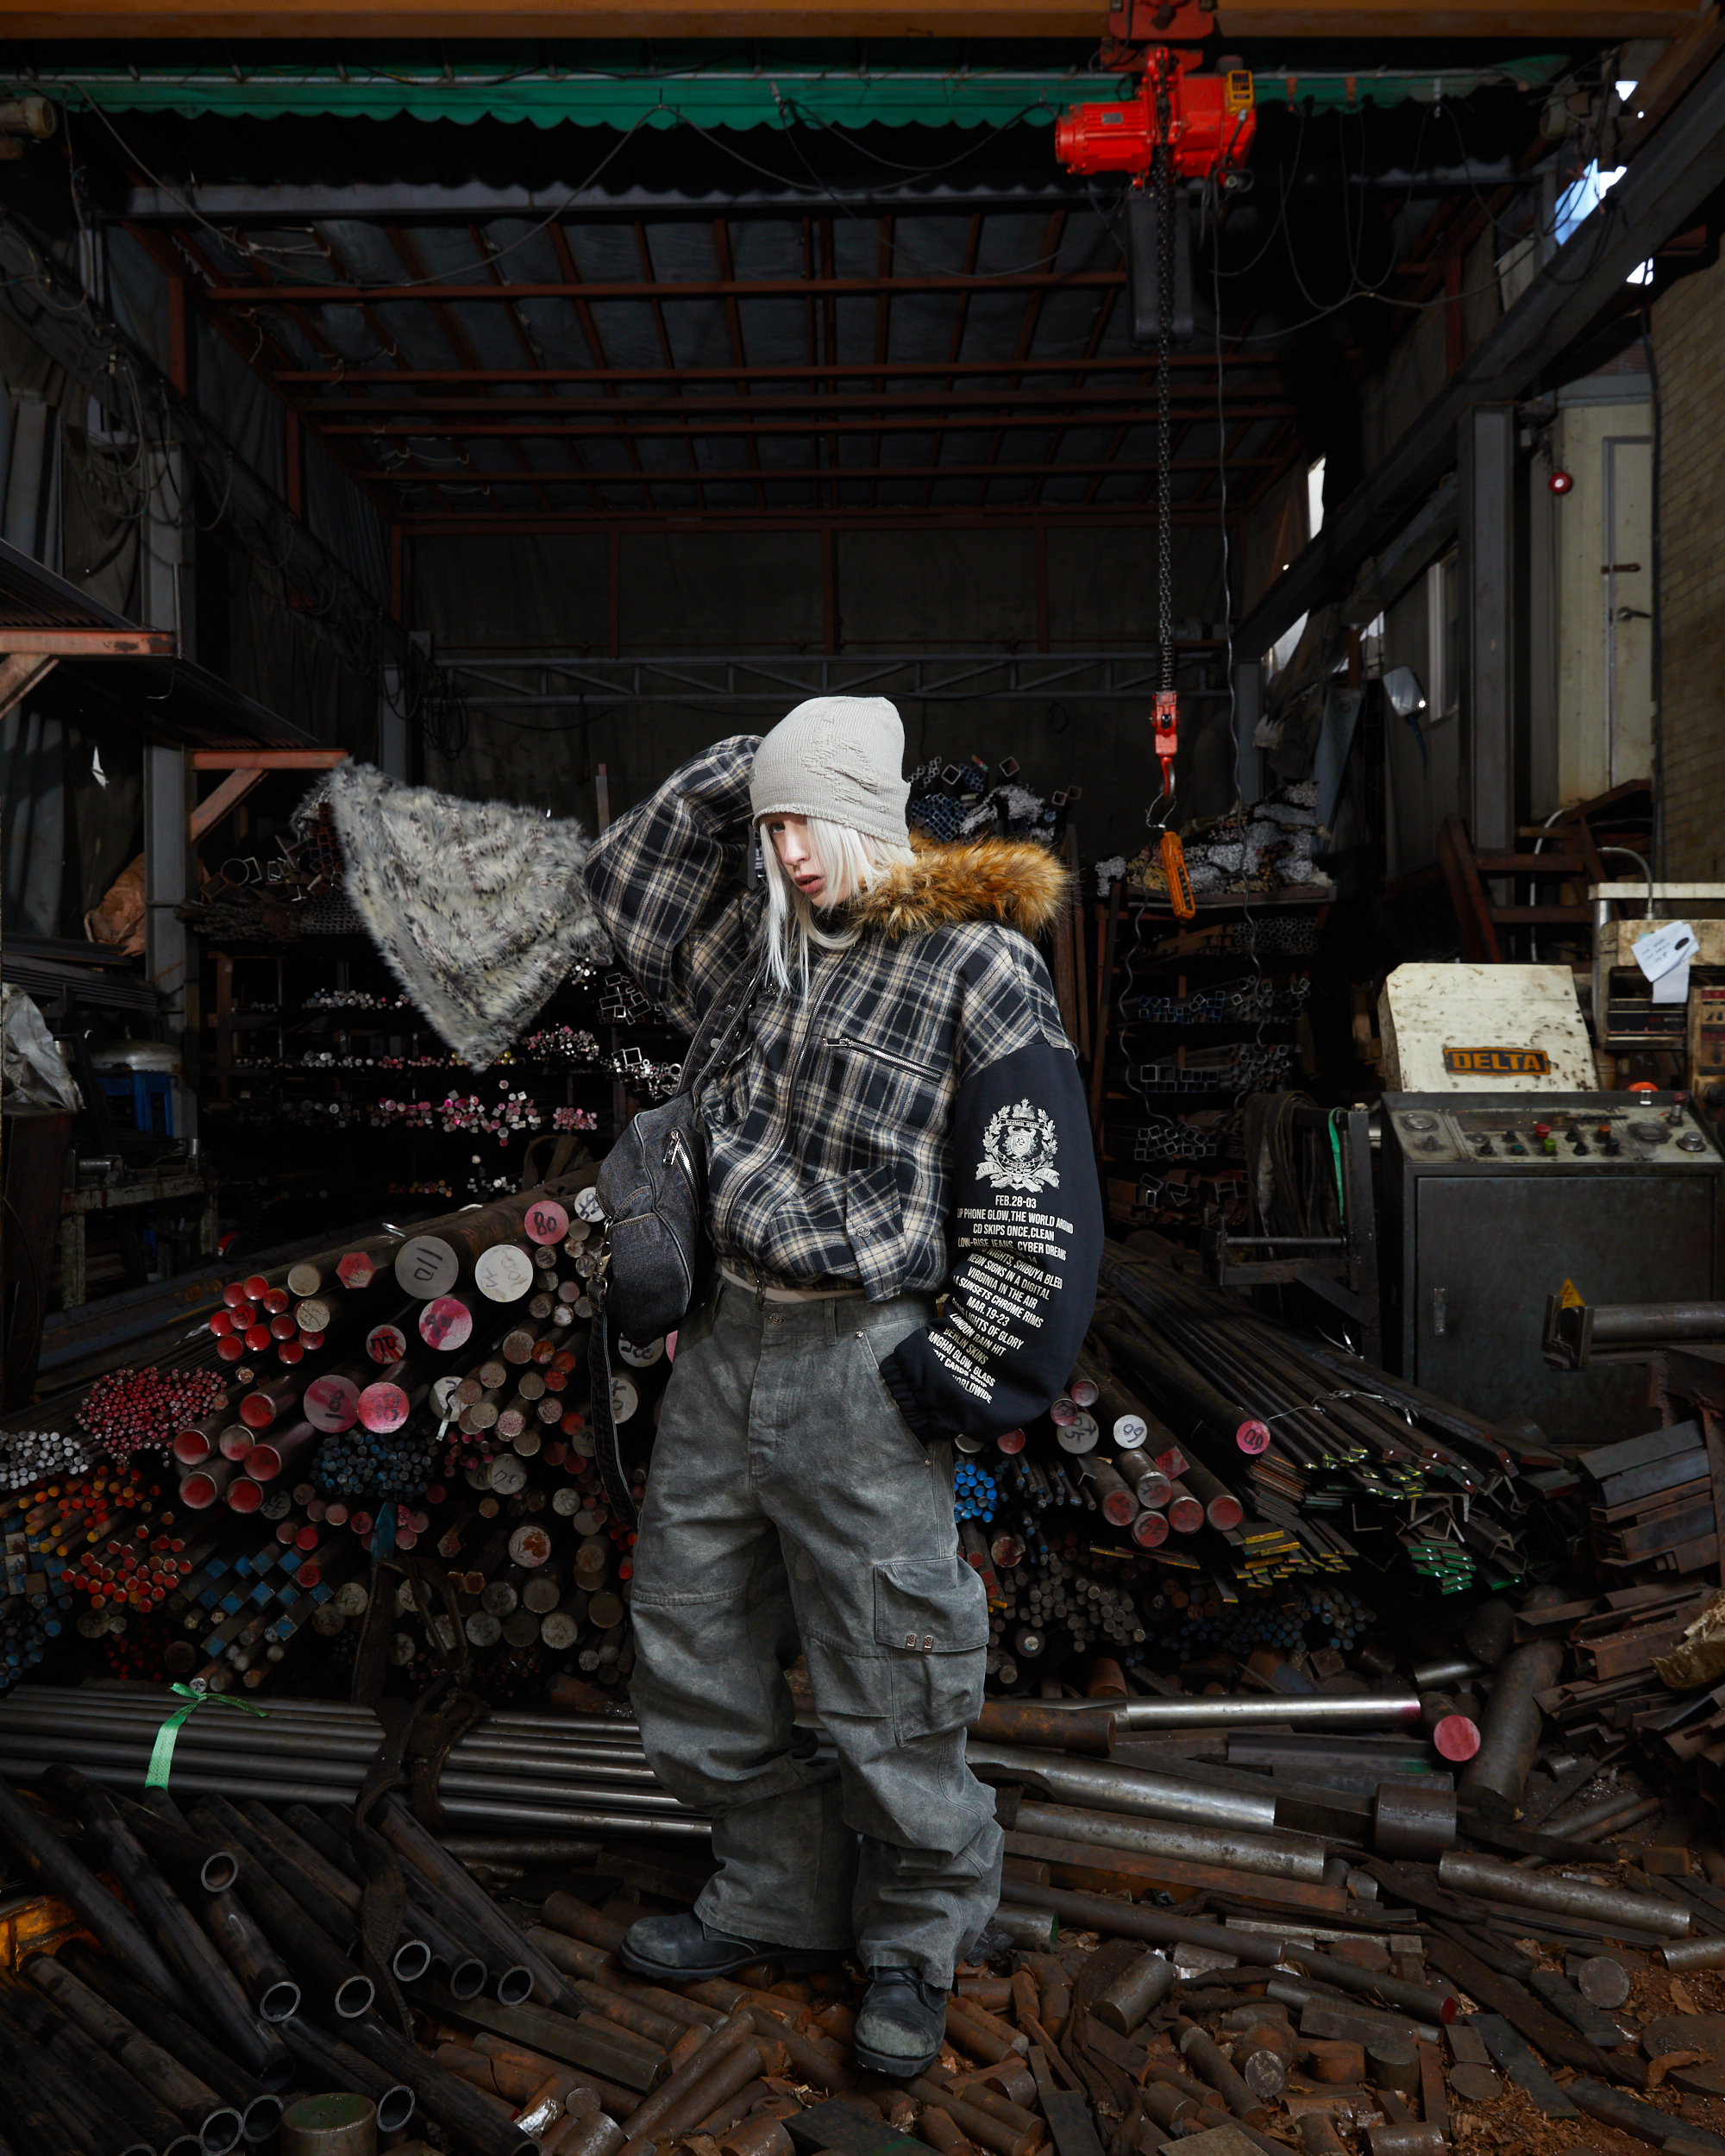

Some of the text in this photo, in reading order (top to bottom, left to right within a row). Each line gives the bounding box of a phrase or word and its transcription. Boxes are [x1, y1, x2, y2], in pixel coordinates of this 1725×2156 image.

[1452, 1052, 1541, 1070] DELTA
[963, 1209, 987, 1220] PHONE
[1028, 1213, 1055, 1227] WORLD
[973, 1223, 982, 1234] CD
[983, 1225, 1006, 1236] SKIPS
[1018, 1240, 1044, 1254] CYBER
[967, 1253, 1051, 1300] NEON SIGNS IN A DIGITAL
[1013, 1259, 1044, 1282] SHIBUYA
[958, 1277, 993, 1300] SUNSETS
[990, 1294, 1025, 1319] CHROME
[1022, 1309, 1044, 1329] RIMS
[967, 1266, 1038, 1310] VIRGINIA IN THE AIR
[943, 1327, 989, 1365] BERLIN SKINS
[950, 1313, 1007, 1357] LONDON RAIN HIT
[987, 1325, 1001, 1338] OF
[997, 1330, 1025, 1351] GLORY
[927, 1331, 956, 1356] ANGHAI
[973, 1365, 996, 1387] GLASS
[950, 1373, 993, 1404] ORLDWIDE
